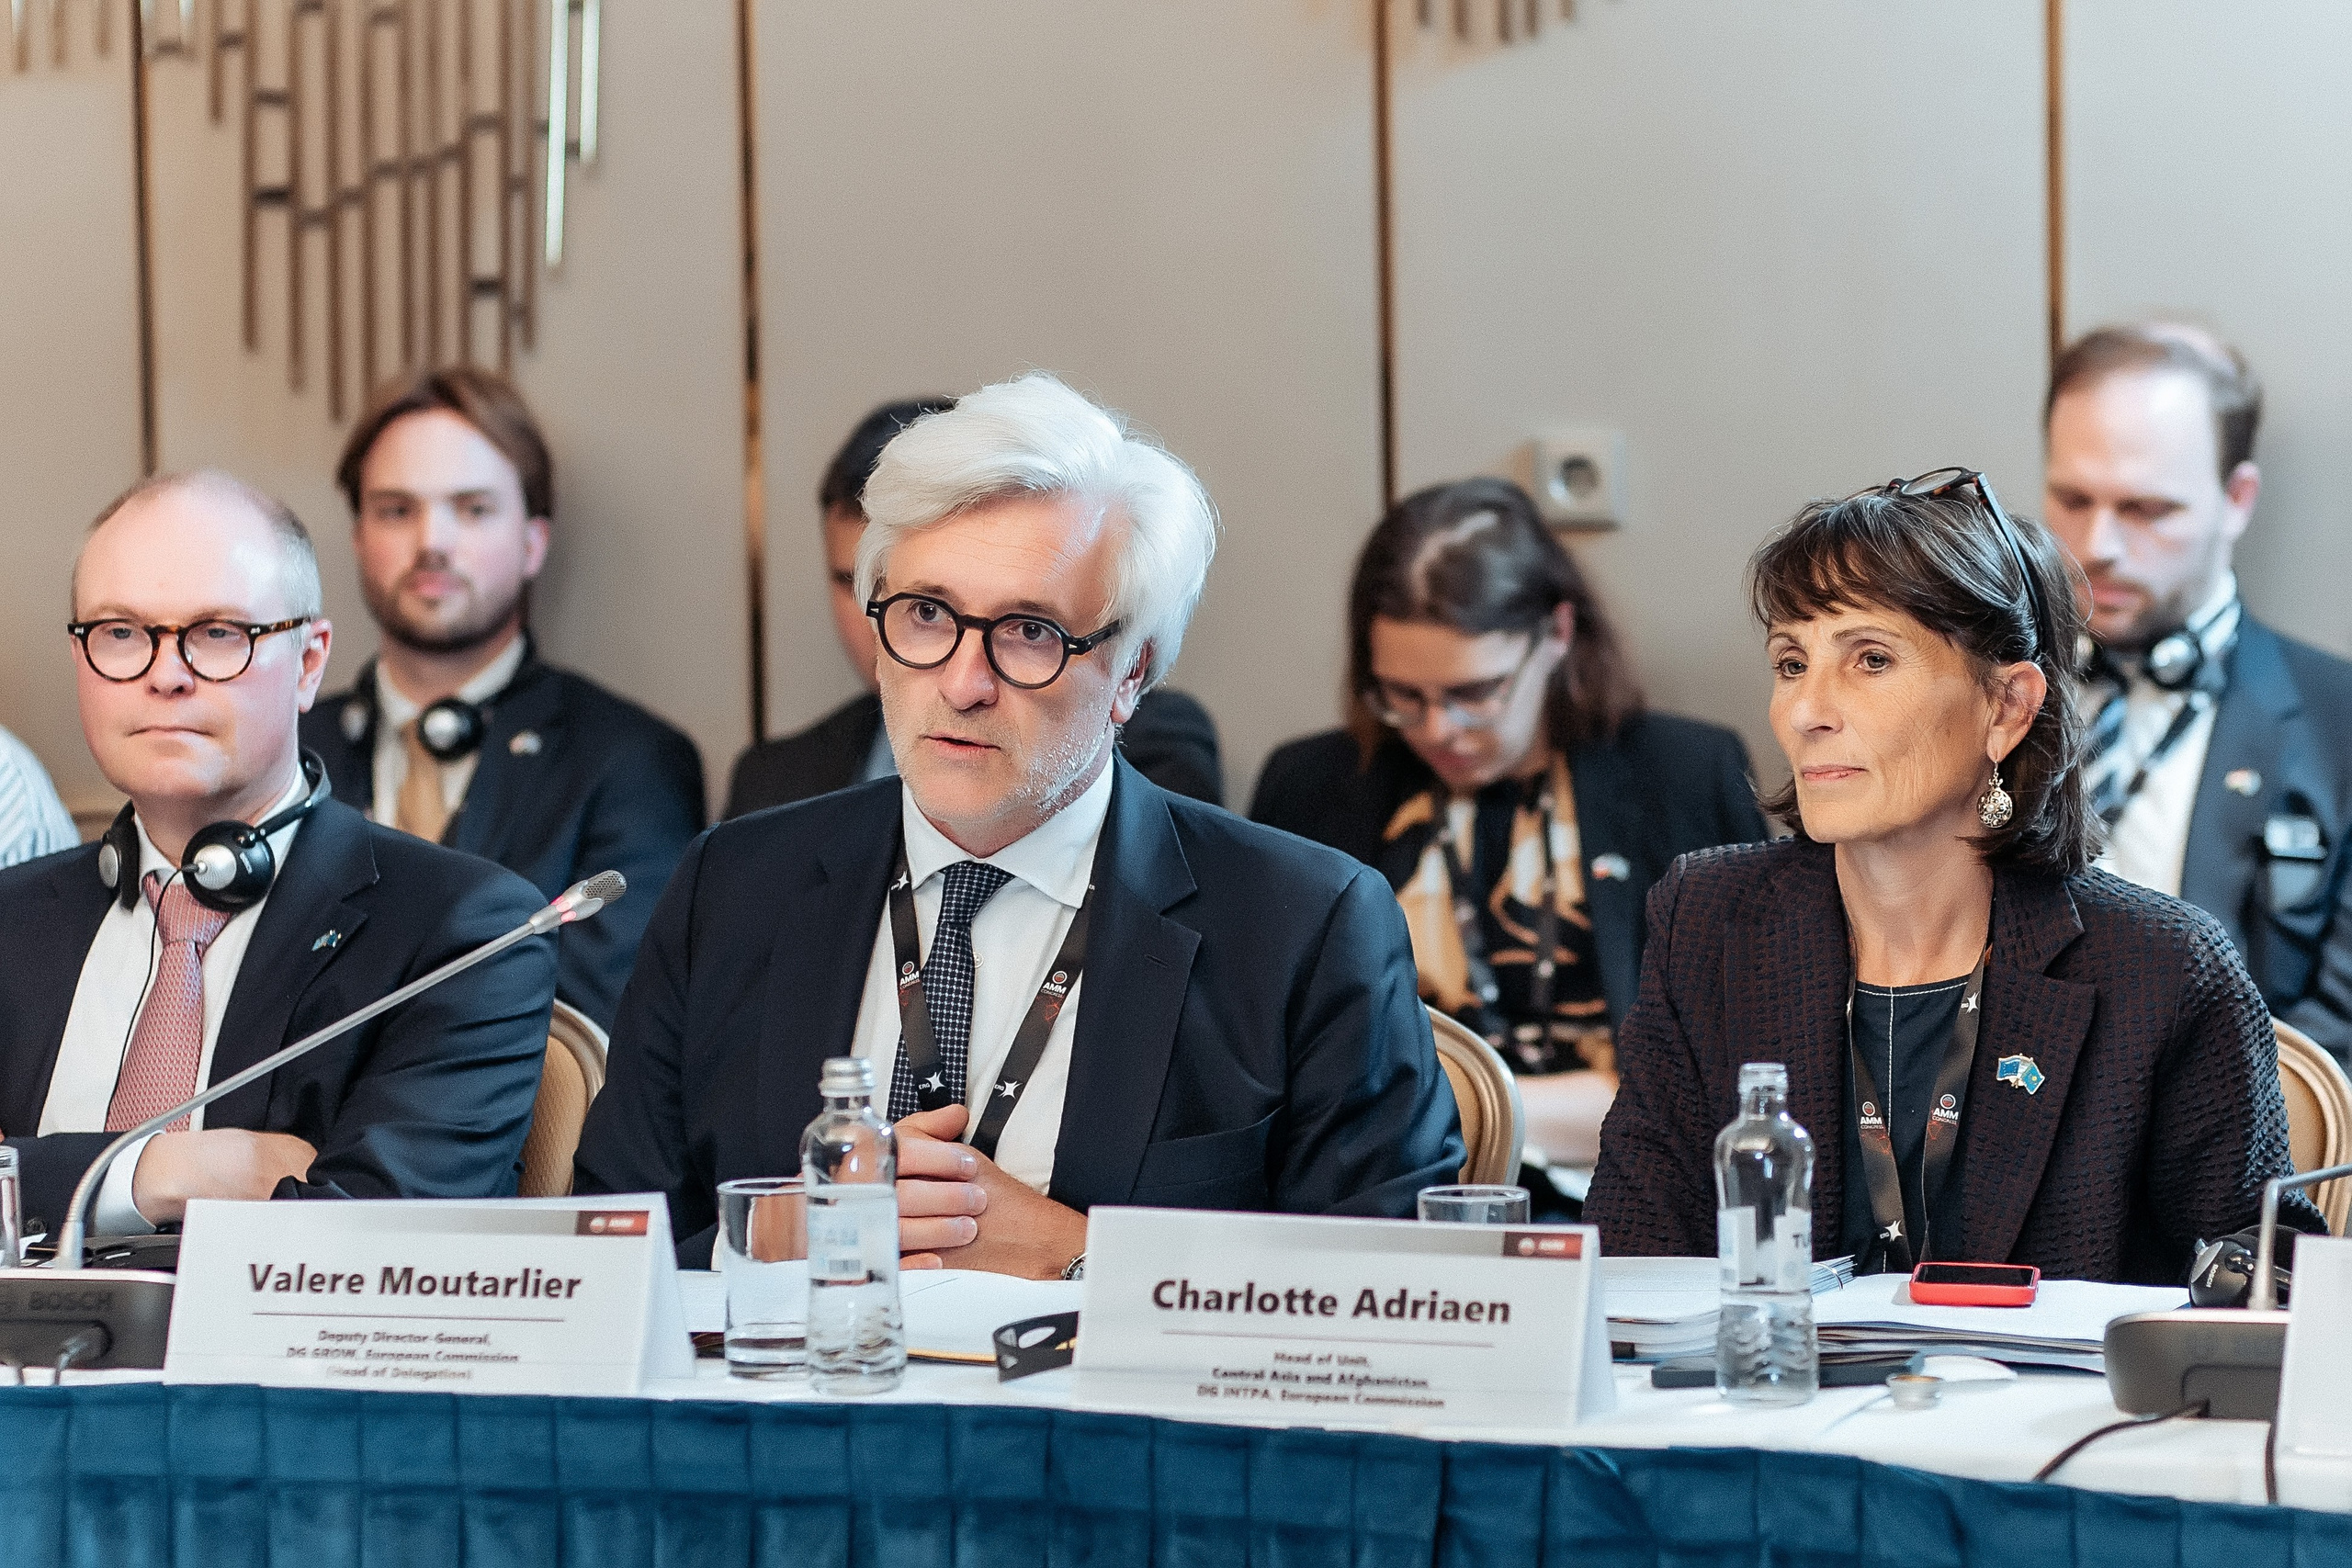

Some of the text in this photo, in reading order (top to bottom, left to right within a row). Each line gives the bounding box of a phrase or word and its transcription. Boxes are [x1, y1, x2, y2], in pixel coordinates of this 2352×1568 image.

[899, 970, 920, 987] AMM
[1042, 982, 1068, 994] AMM
[1860, 1116, 1883, 1125] AMM
[1933, 1108, 1960, 1121] AMM
[248, 1262, 582, 1300] Valere Moutarlier
[1151, 1279, 1511, 1325] Charlotte Adriaen
